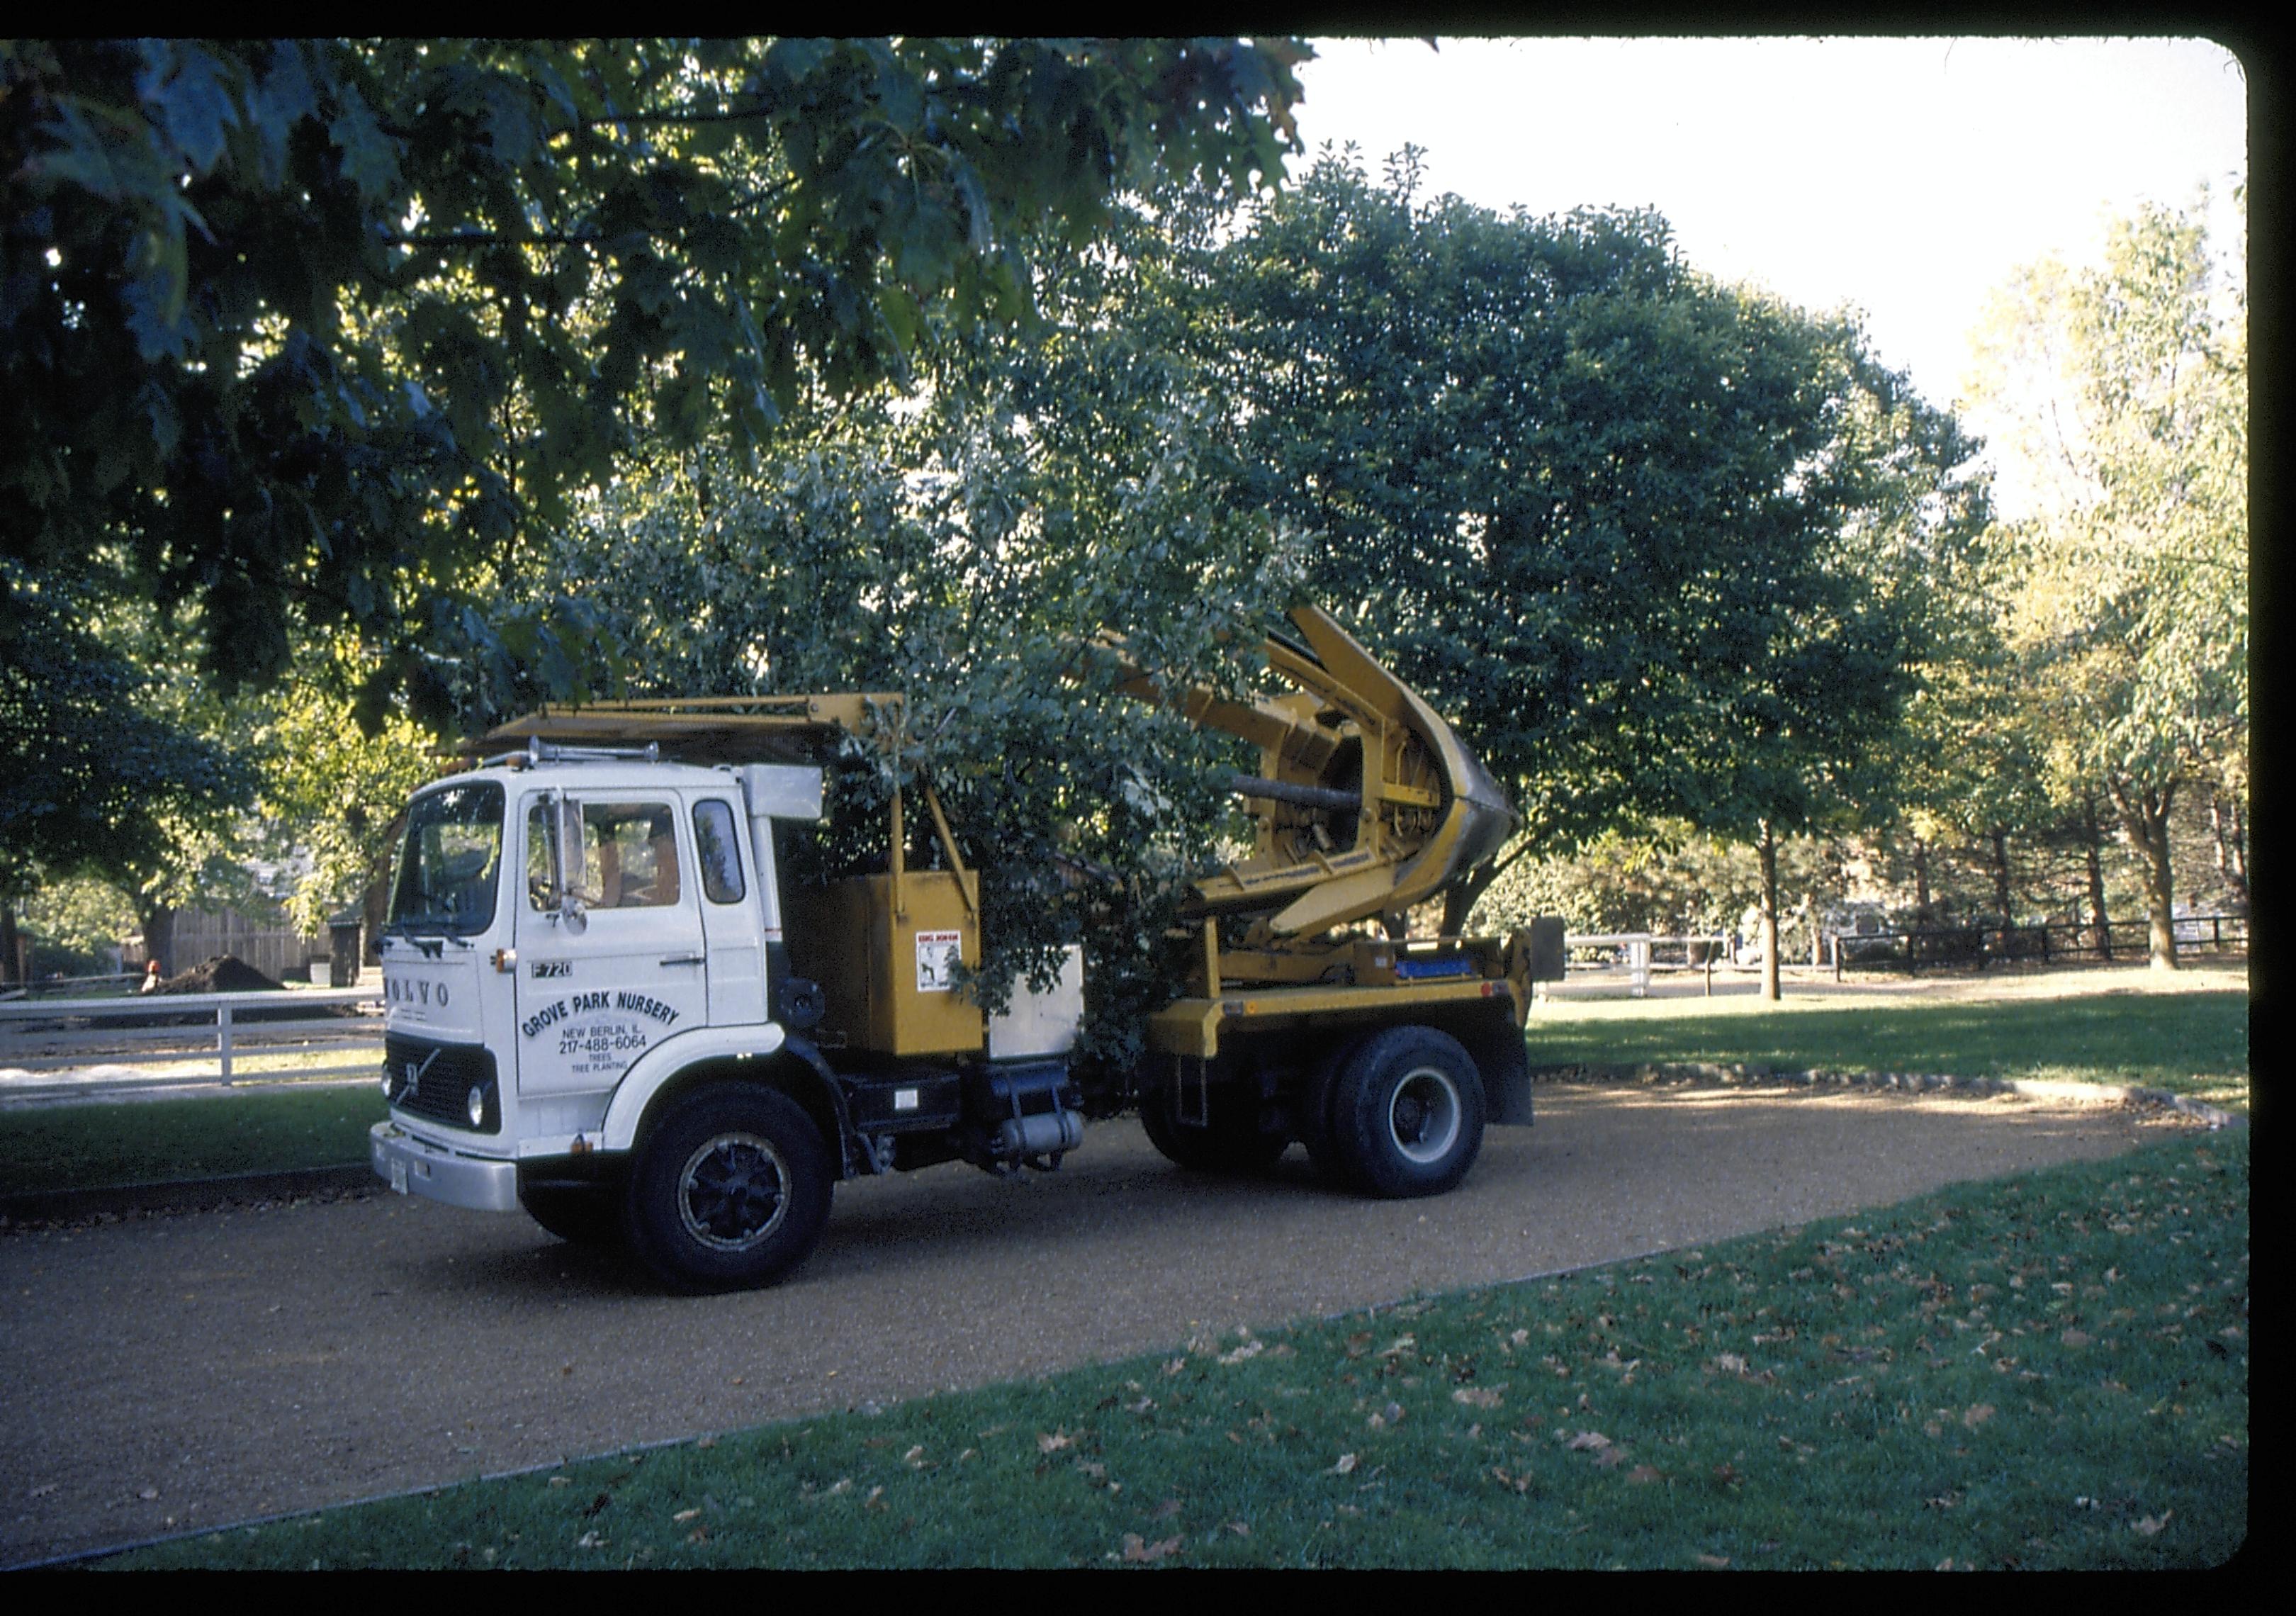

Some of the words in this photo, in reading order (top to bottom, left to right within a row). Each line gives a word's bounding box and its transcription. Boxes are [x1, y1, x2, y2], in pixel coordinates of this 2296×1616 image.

[522, 1001, 568, 1038] GROVE
[573, 991, 610, 1014] PARK
[617, 991, 680, 1026] NURSERY
[563, 1028, 585, 1039] NEW
[559, 1035, 646, 1055] 217-488-6064
[572, 1064, 590, 1073] TREE
